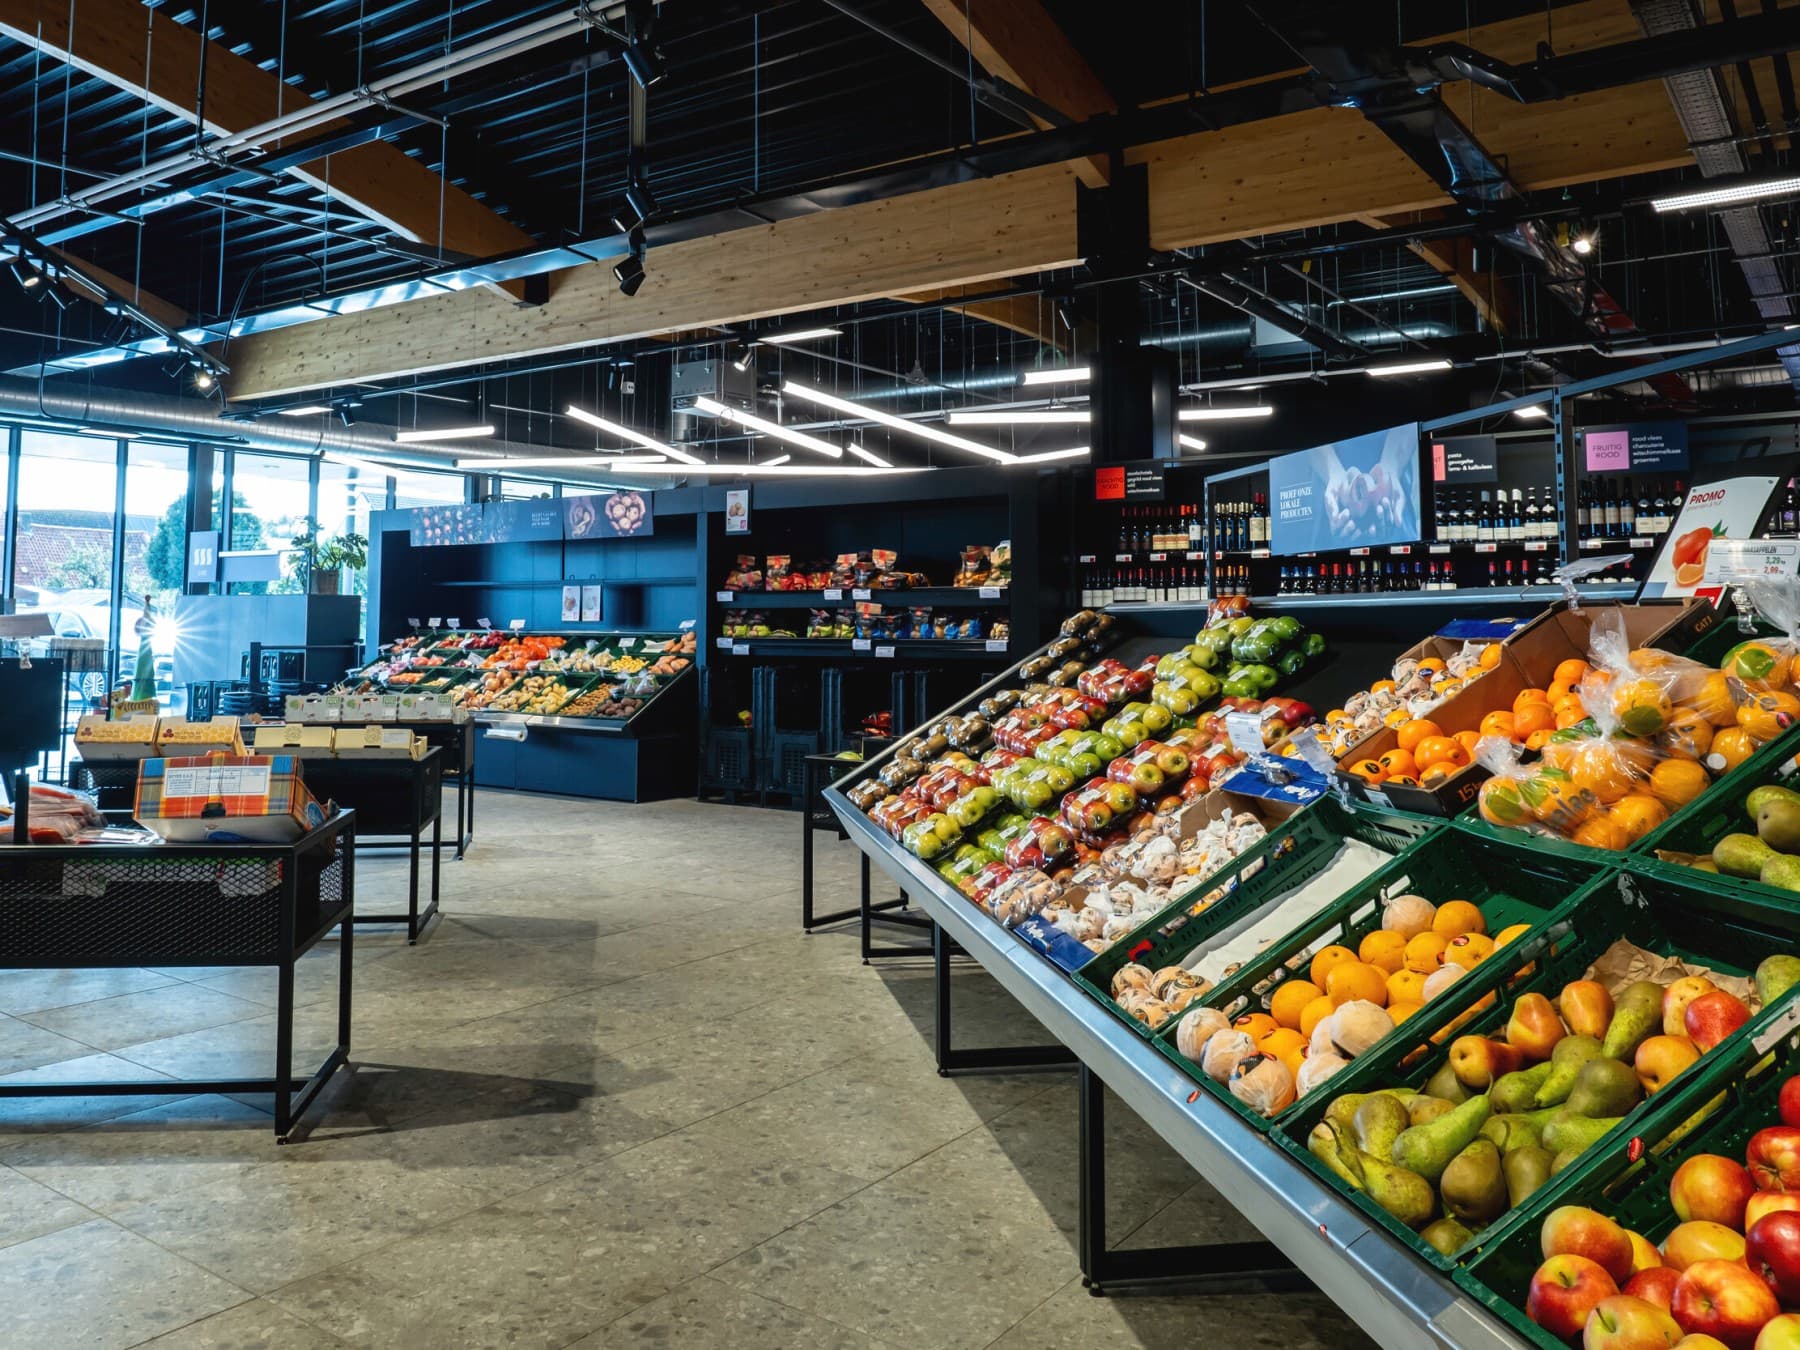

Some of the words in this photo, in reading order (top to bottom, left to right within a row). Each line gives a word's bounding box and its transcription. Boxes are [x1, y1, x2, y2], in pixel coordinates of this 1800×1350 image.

[1592, 444, 1623, 452] FRUITIG
[1280, 489, 1297, 500] PROEF
[1297, 486, 1312, 496] ONZE
[1689, 489, 1726, 505] PROMO
[1280, 498, 1300, 510] LOKALE
[1280, 506, 1313, 520] PRODUCTEN
